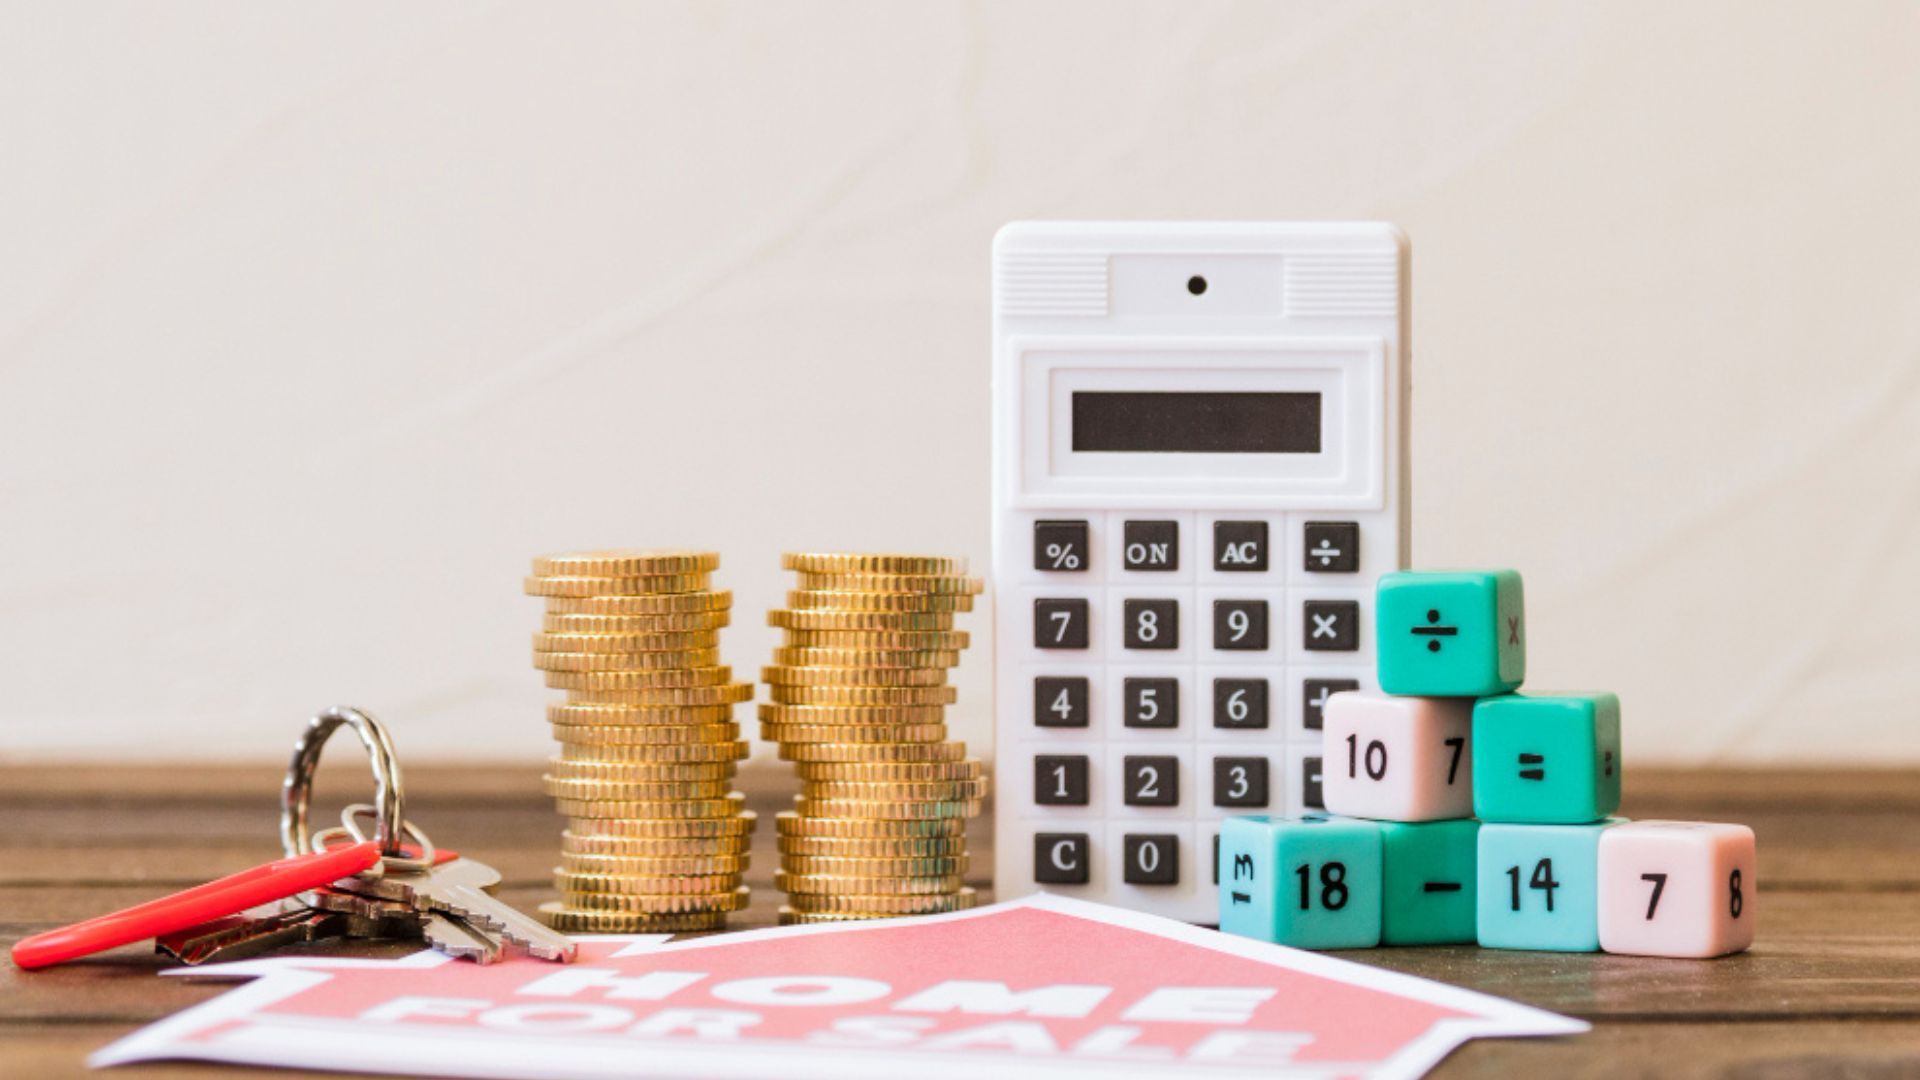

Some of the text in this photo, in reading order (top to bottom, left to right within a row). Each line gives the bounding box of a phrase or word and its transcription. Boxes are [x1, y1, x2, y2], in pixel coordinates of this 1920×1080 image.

[1046, 543, 1079, 568] %
[1126, 543, 1169, 564] ON
[1220, 541, 1257, 564] AC
[1050, 611, 1071, 642] 7
[1137, 609, 1158, 642] 8
[1227, 609, 1249, 642] 9
[1051, 688, 1072, 720] 4
[1138, 689, 1158, 721] 5
[1227, 688, 1248, 721] 6
[1345, 733, 1387, 781] 10
[1443, 737, 1465, 786] 7
[1053, 766, 1249, 798] 1 2 3
[1051, 840, 1159, 873] C 0
[1295, 861, 1349, 911] 18
[1506, 857, 1560, 912] 14
[1641, 873, 1667, 920] 7
[1728, 868, 1743, 919] 8
[514, 968, 1278, 1024] HOME
[356, 995, 1317, 1064] FOR SALE
